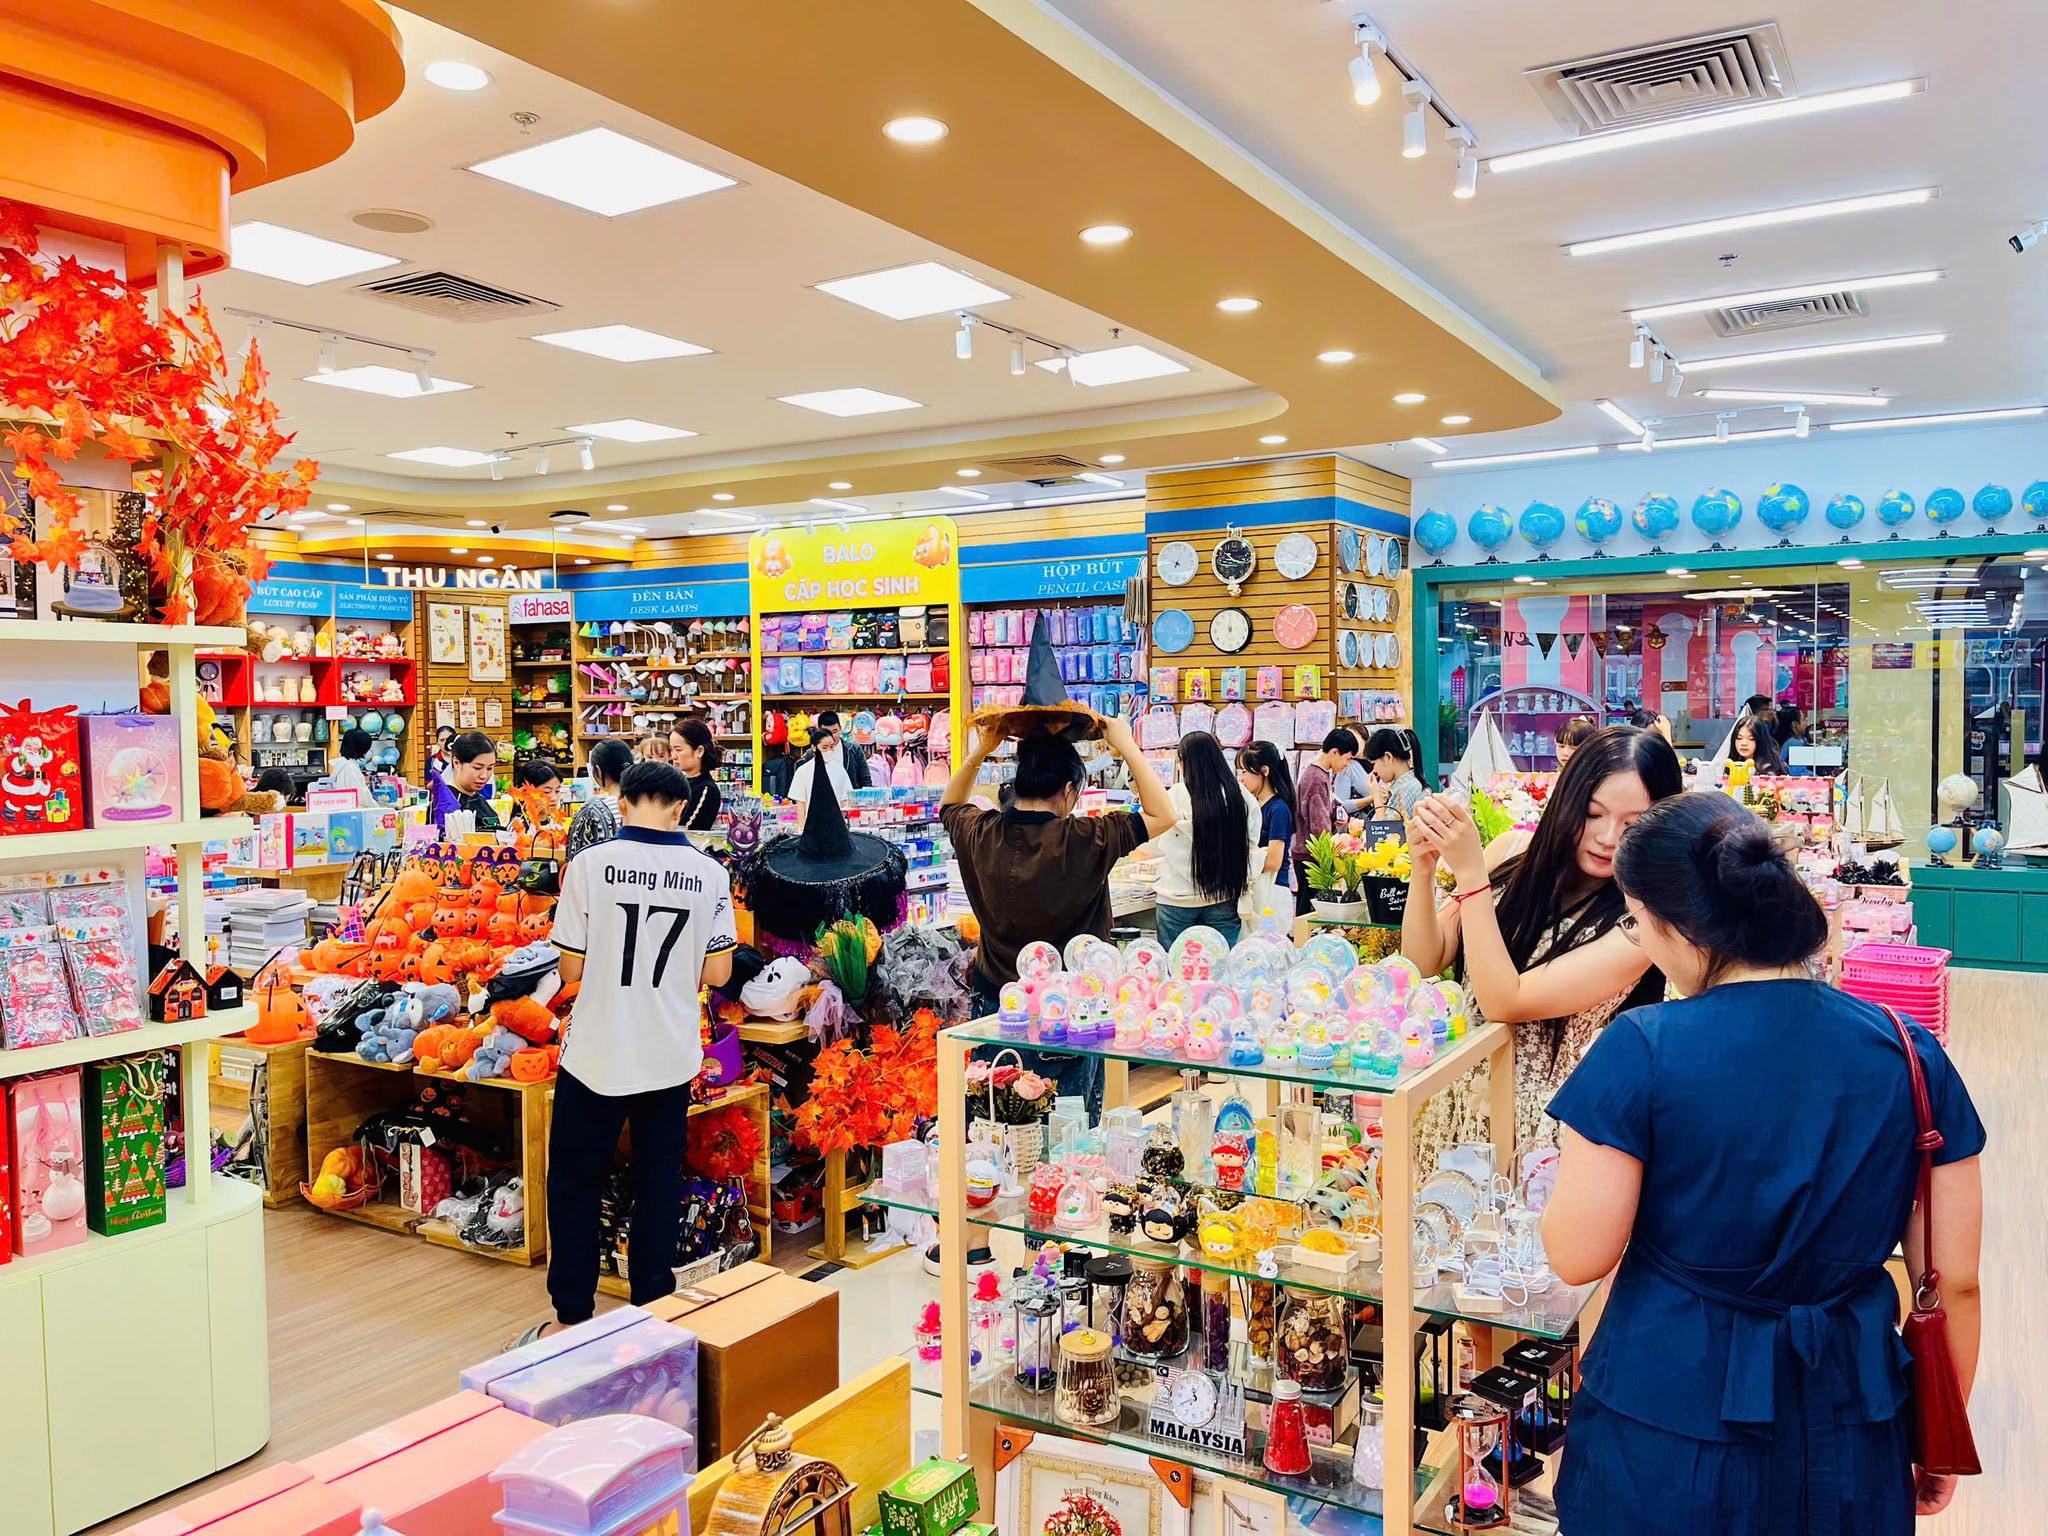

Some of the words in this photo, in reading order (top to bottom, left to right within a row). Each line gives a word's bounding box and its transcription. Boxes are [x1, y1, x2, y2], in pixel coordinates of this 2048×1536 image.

[823, 542, 876, 564] BALO
[381, 566, 447, 589] THU
[455, 563, 542, 590] NGÂN
[1043, 561, 1081, 580] HỘP
[1087, 558, 1123, 575] BÚT
[257, 585, 277, 596] BÚT
[280, 588, 301, 598] CAO
[303, 586, 323, 599] CẤP
[632, 590, 662, 602] ĐÈN
[665, 588, 695, 600] BÀN
[784, 577, 822, 605] CẶP
[827, 578, 868, 603] HỌC
[872, 575, 919, 597] SINH
[1037, 582, 1090, 595] PENCIL
[263, 599, 295, 608] LUXURY
[296, 600, 318, 610] PENS
[523, 598, 570, 618] fahasa
[630, 606, 660, 615] DESK
[661, 603, 699, 615] LAMPS
[604, 865, 657, 891] Quang
[663, 870, 702, 893] Minh
[615, 902, 690, 989] 17
[1150, 1418, 1244, 1454] MALAYSIA
